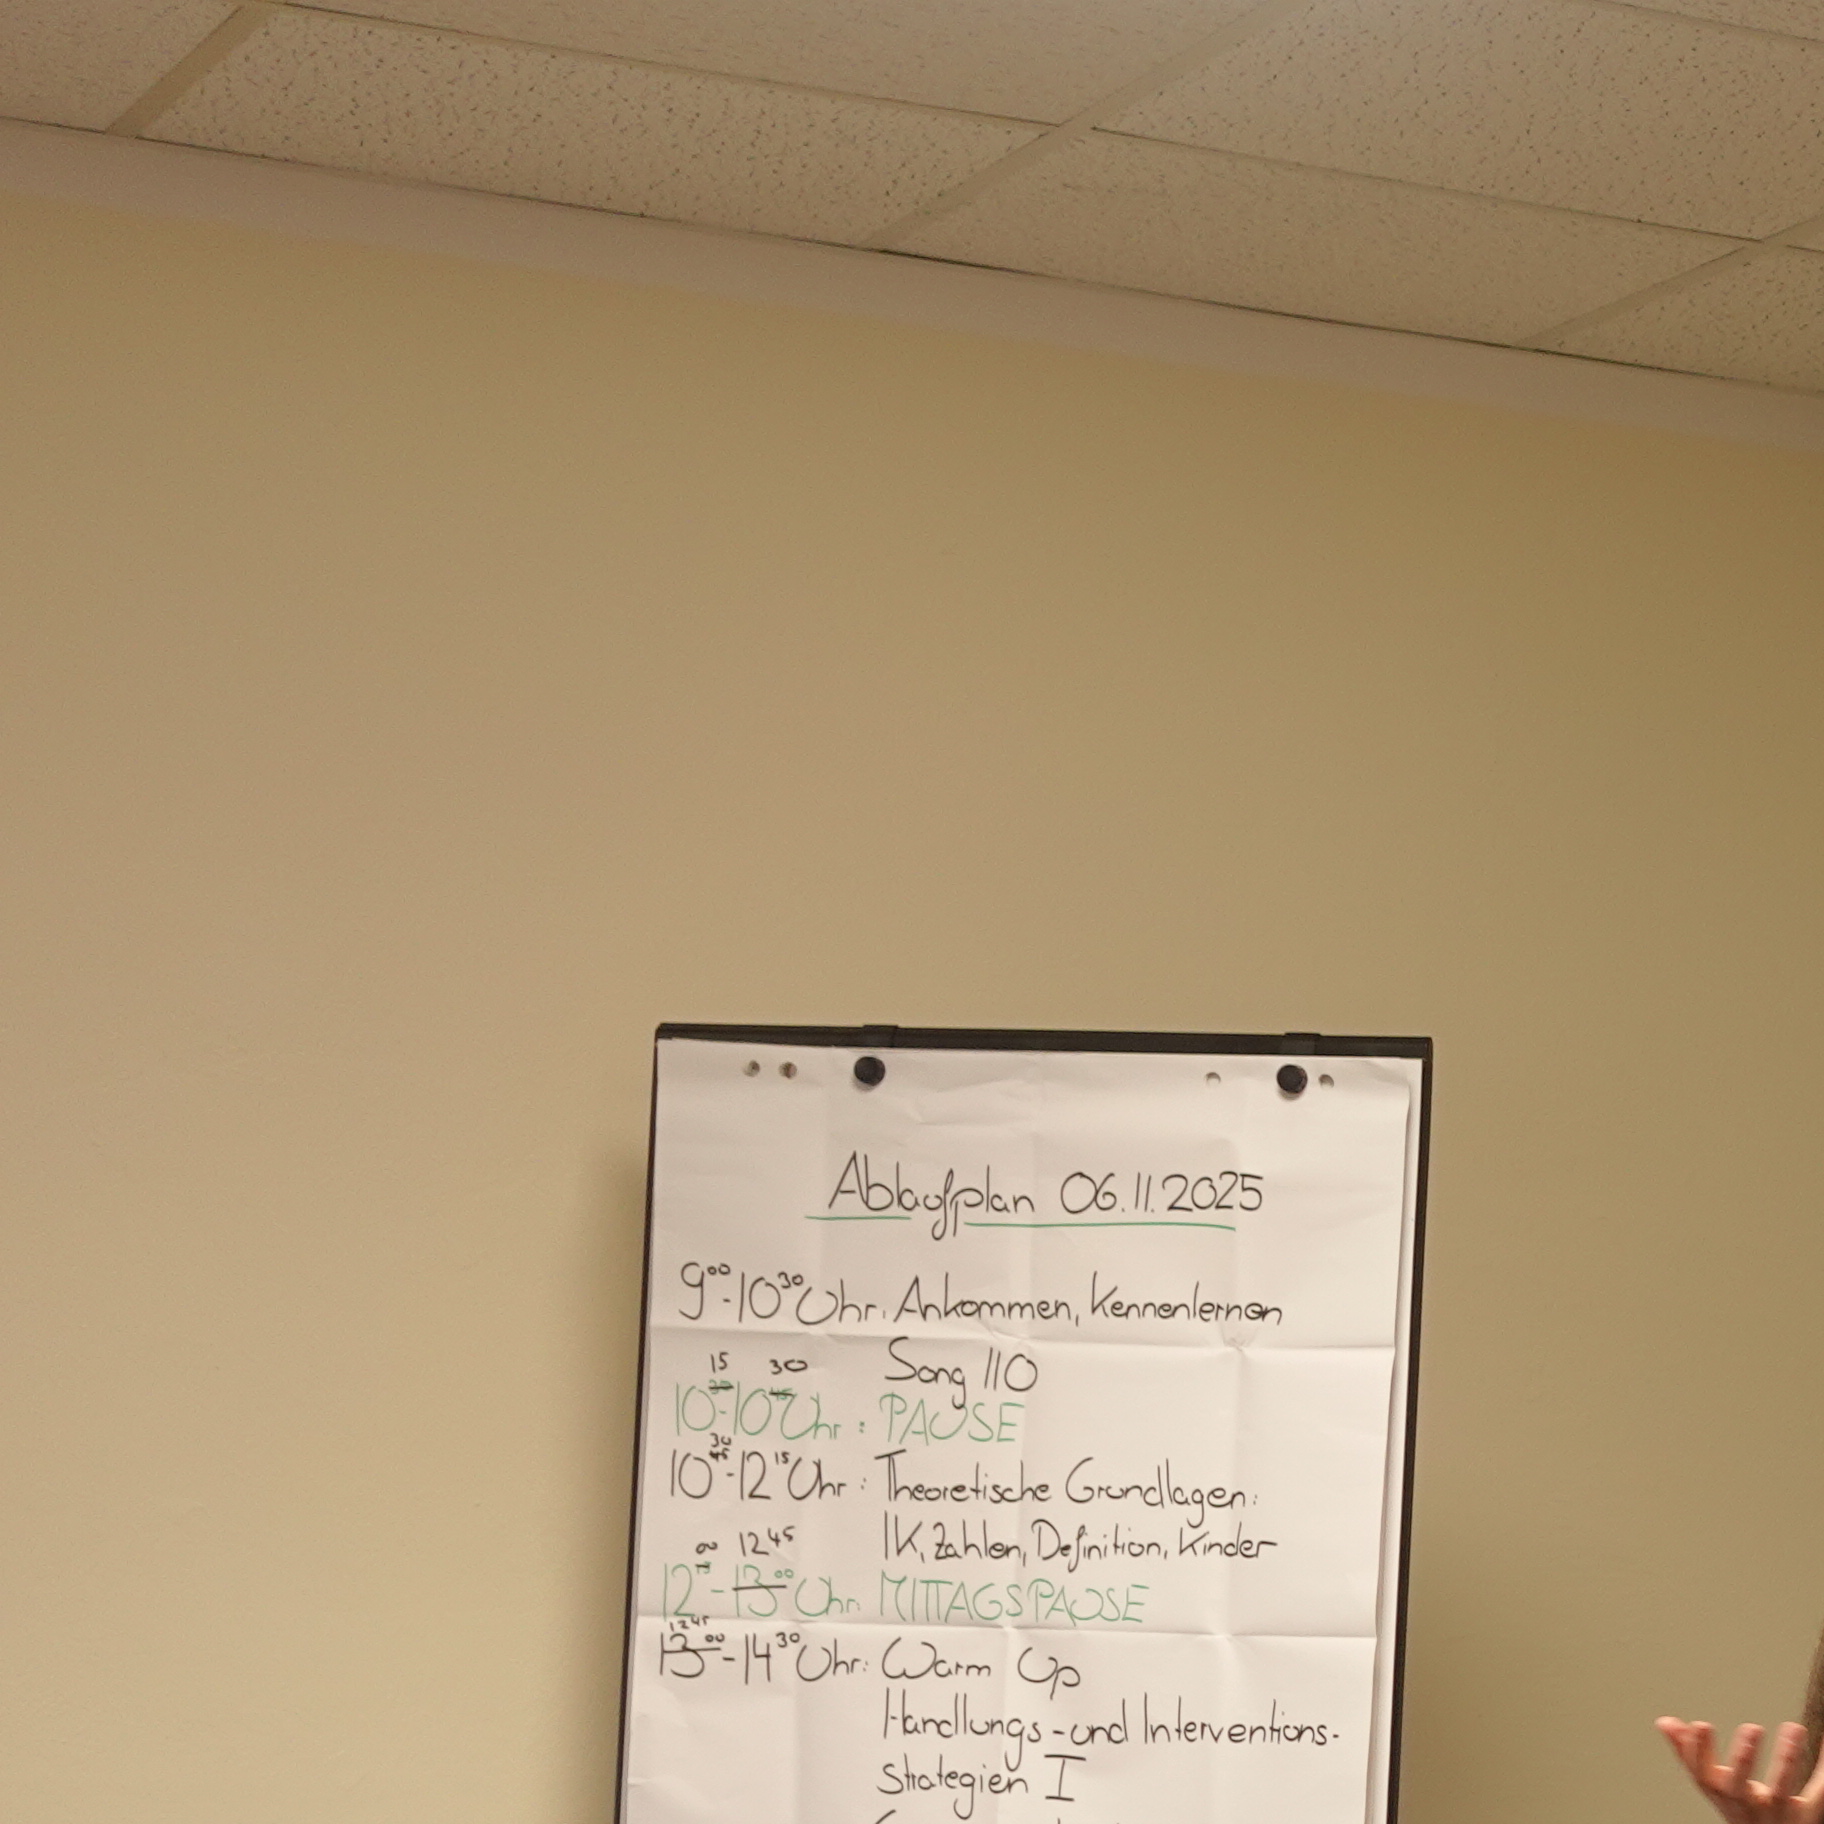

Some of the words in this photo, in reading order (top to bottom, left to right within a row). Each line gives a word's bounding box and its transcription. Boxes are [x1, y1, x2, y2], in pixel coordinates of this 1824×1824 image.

[1060, 1171, 1263, 1216] 06.11.2025
[894, 1274, 1080, 1328] Ankommen,
[1090, 1271, 1283, 1326] Kennenlernen
[884, 1337, 967, 1410] Song
[985, 1348, 1038, 1393] 110
[879, 1400, 1025, 1447] PAUSE
[874, 1449, 1050, 1505] Theoretische
[1031, 1520, 1168, 1571] Definition,
[1179, 1520, 1278, 1561] Kinder
[880, 1575, 1150, 1625] MITTAGSPAUSE
[882, 1638, 992, 1682] Warm
[1018, 1644, 1082, 1700] Up
